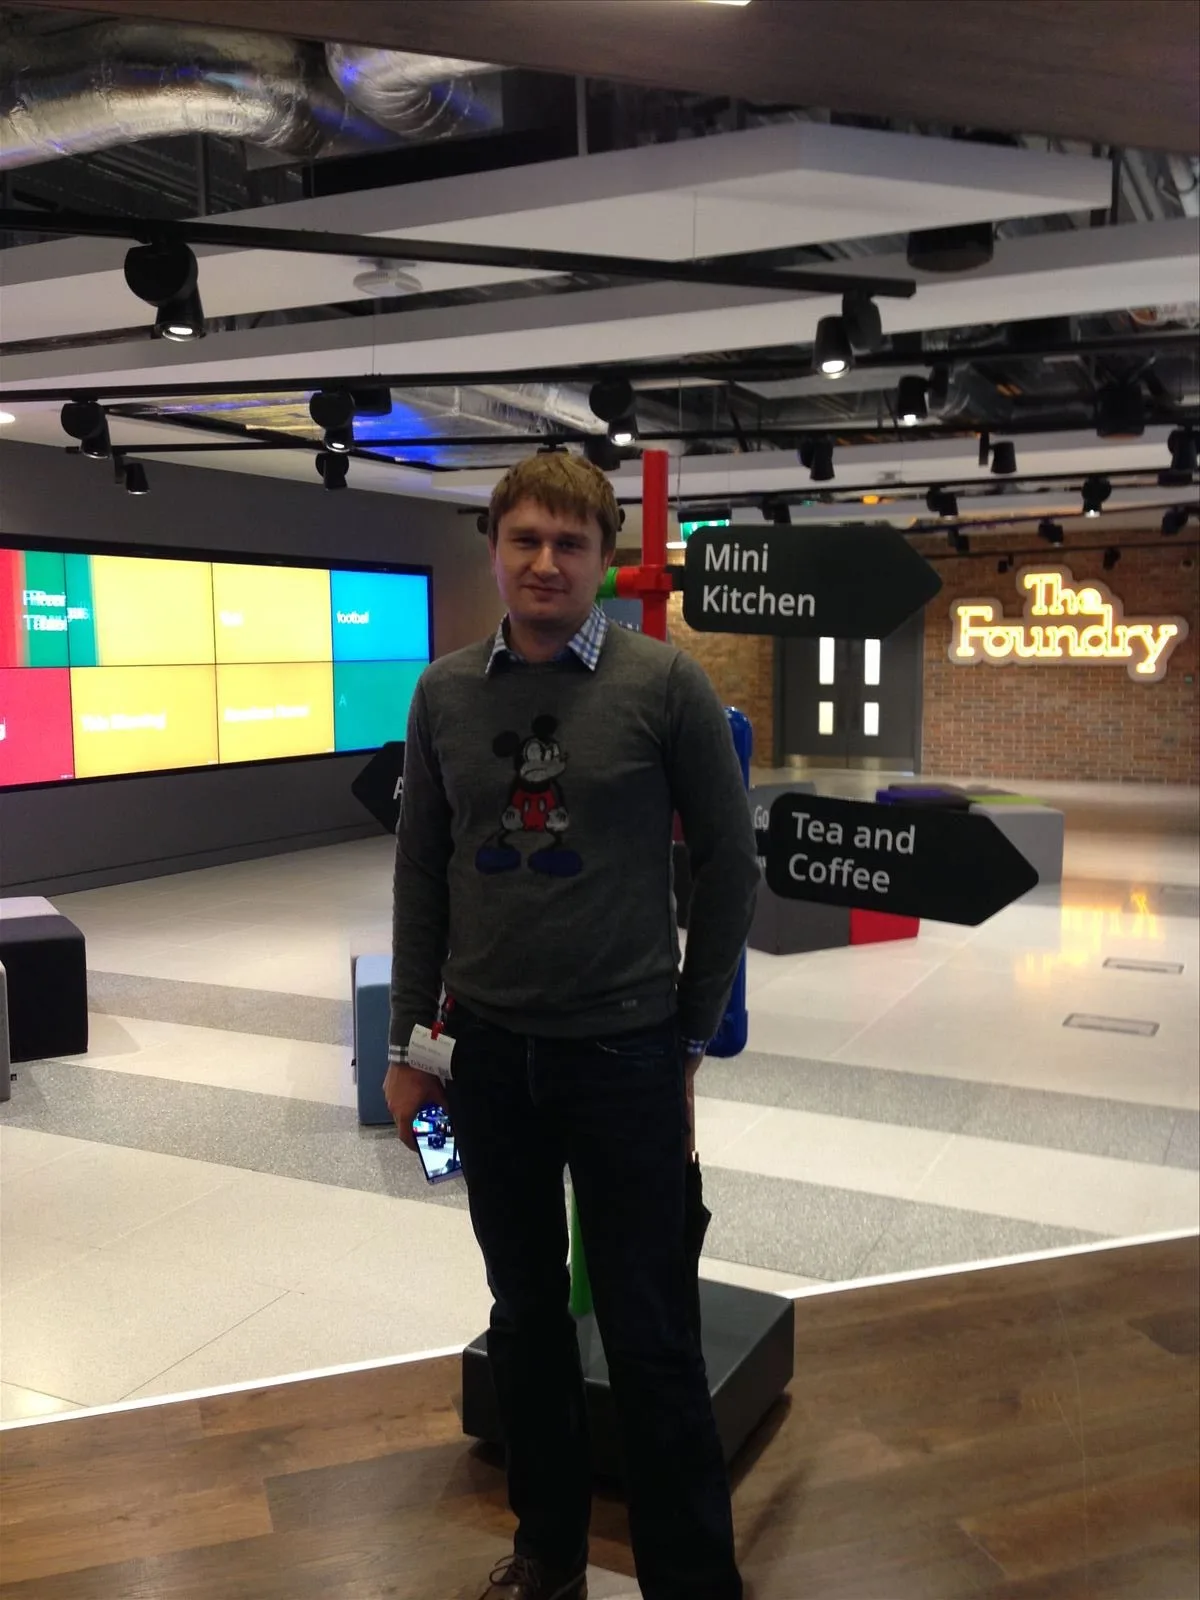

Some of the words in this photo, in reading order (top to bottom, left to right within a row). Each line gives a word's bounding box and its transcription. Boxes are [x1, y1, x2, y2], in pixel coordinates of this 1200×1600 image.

[704, 543, 769, 573] Mini
[702, 585, 816, 617] Kitchen
[1024, 572, 1103, 615] The
[956, 604, 1178, 674] Foundry
[791, 811, 843, 846] Tea
[854, 825, 916, 855] and
[788, 854, 891, 893] Coffee
